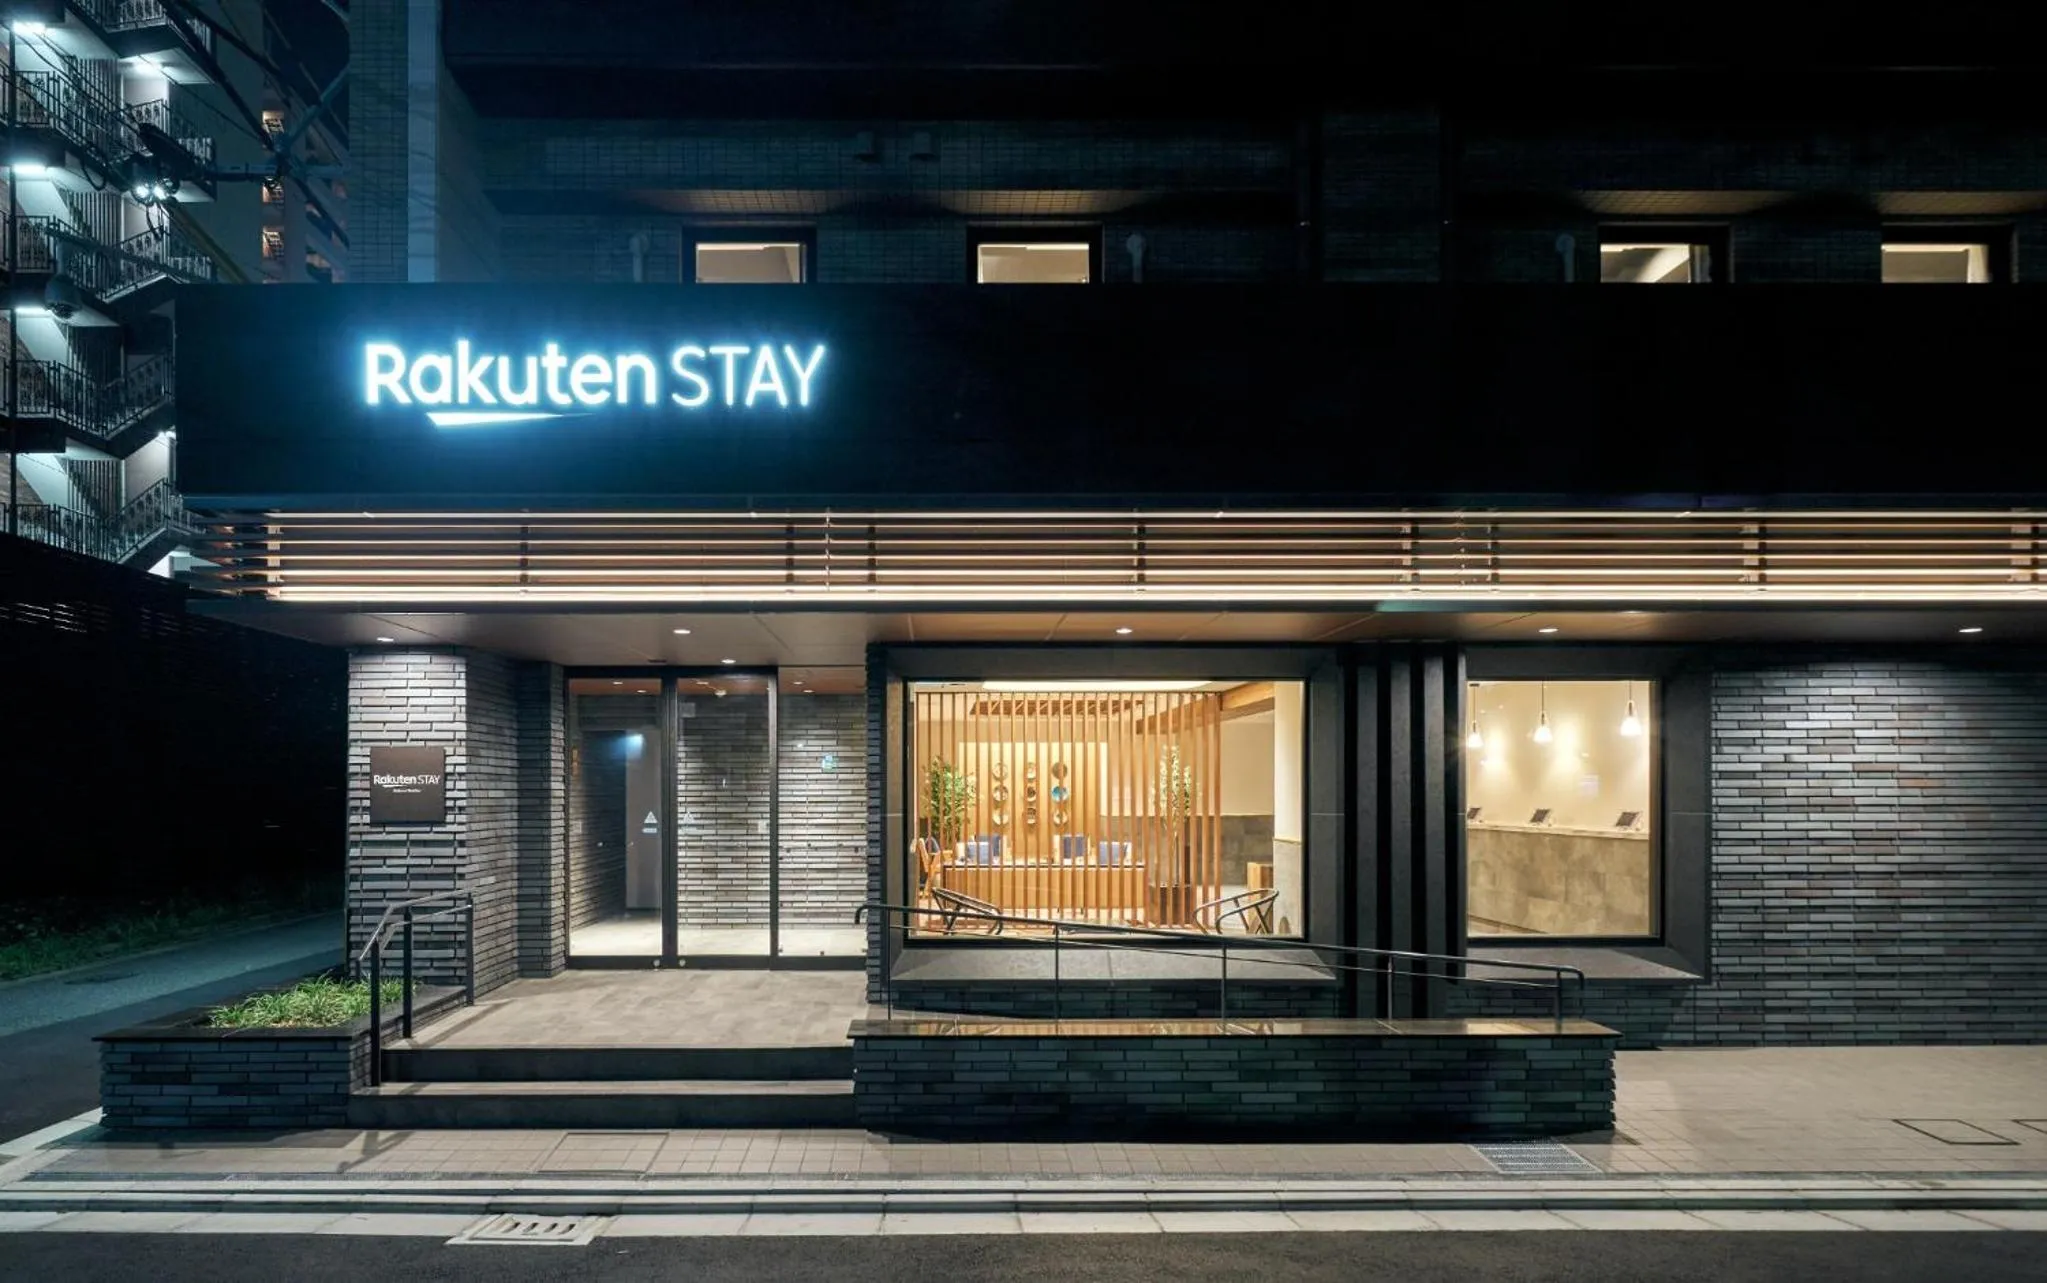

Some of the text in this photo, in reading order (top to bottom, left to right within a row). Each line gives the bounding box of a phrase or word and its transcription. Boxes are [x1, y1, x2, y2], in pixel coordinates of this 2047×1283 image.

[364, 339, 827, 408] Rakuten STAY
[373, 774, 441, 785] Rakuten STAY
